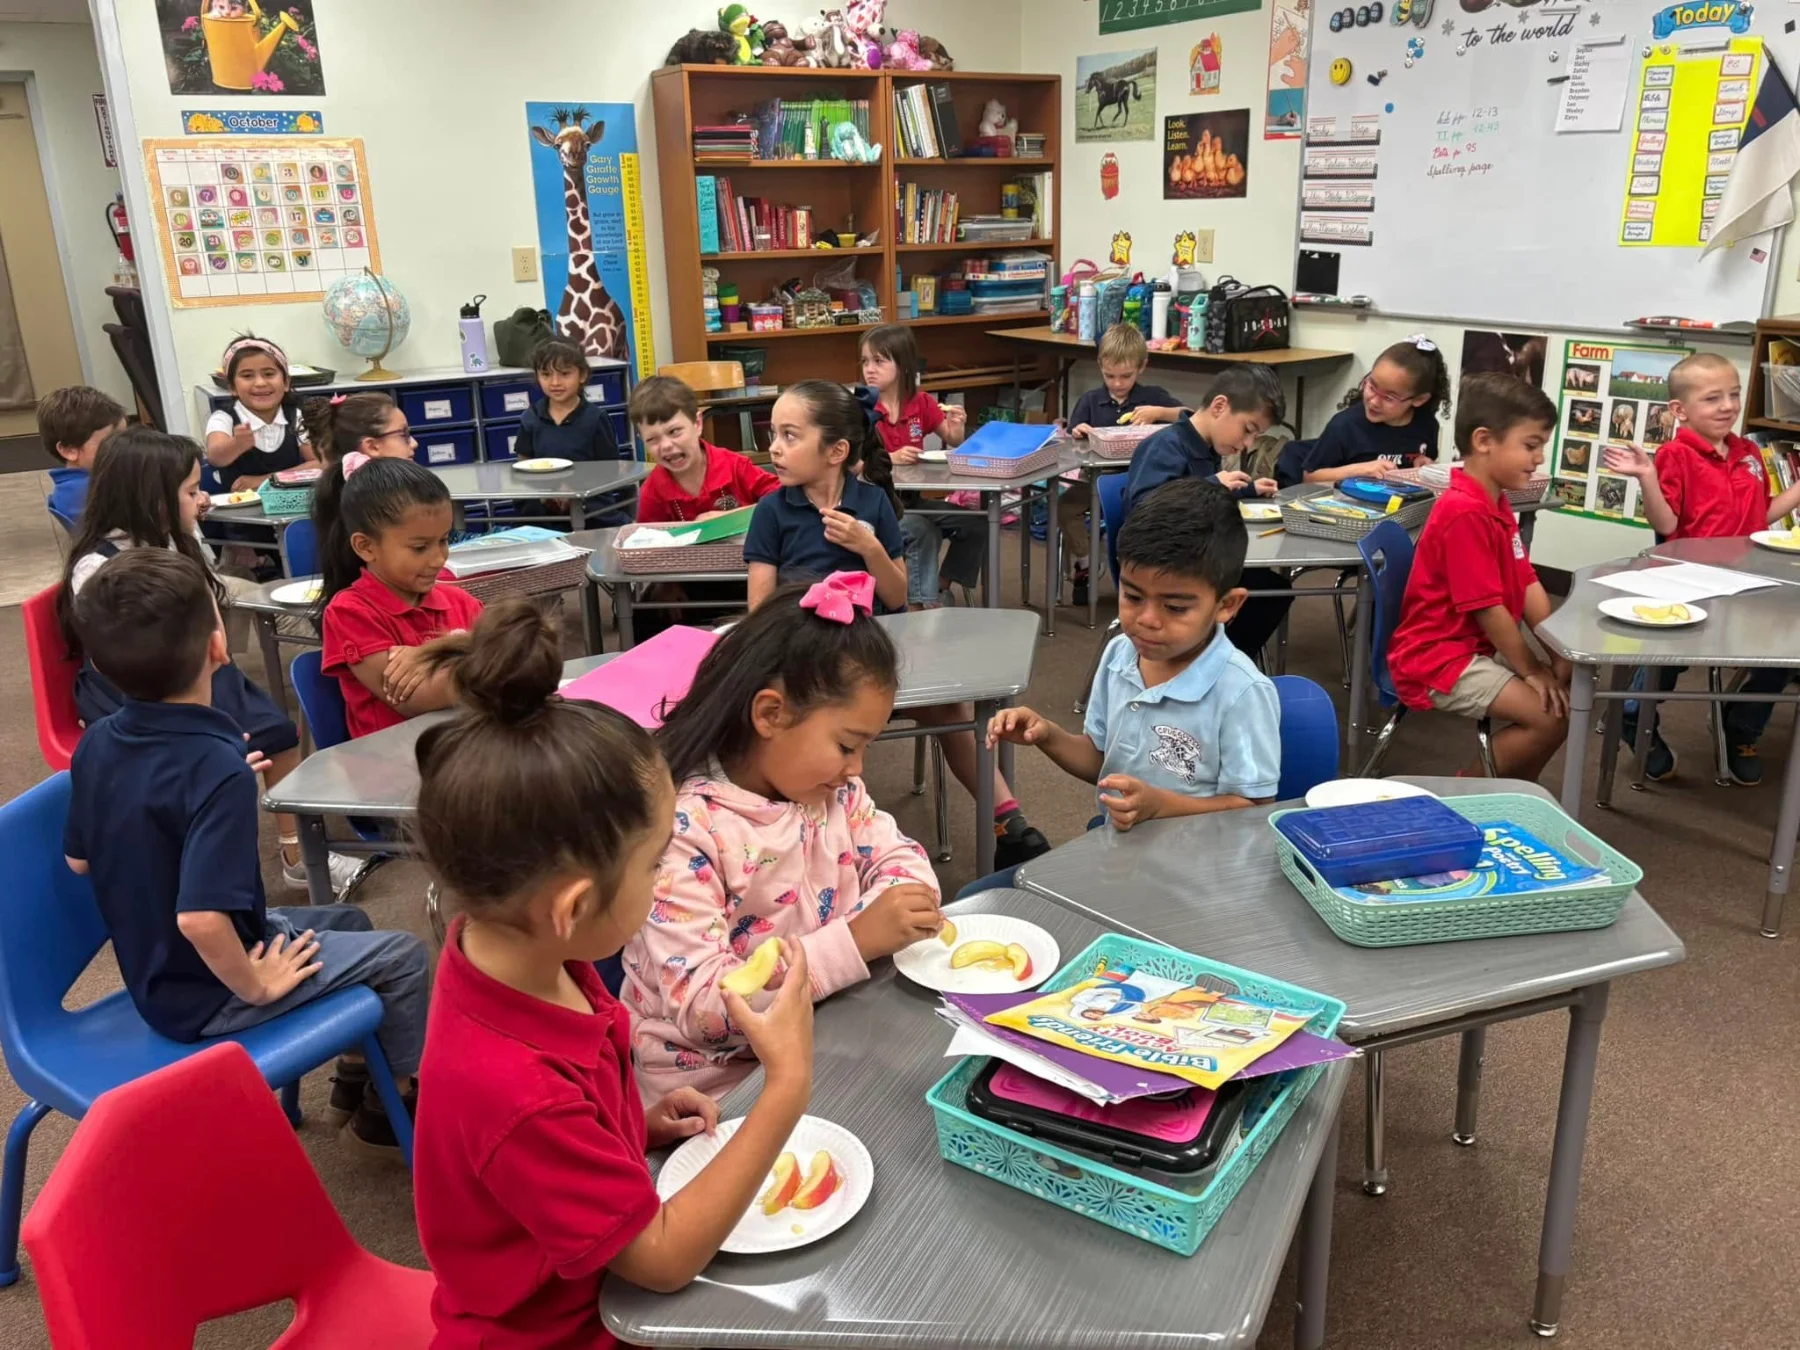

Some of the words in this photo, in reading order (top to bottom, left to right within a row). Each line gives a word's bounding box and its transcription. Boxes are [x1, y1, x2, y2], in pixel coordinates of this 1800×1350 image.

[1113, 1, 1123, 20] 2
[1674, 3, 1735, 25] Today
[1461, 27, 1483, 47] to
[1486, 22, 1516, 45] the
[1521, 13, 1575, 40] world
[230, 117, 278, 128] October
[1168, 120, 1186, 129] Look.
[1168, 130, 1190, 140] Listen.
[1167, 142, 1188, 151] Learn.
[590, 154, 612, 165] Gary
[586, 165, 617, 174] Giraffe
[1427, 163, 1466, 179] Spelling
[586, 176, 620, 184] Growth
[588, 186, 619, 196] Gauge
[180, 237, 192, 247] 20
[1572, 344, 1608, 359] Farm
[1484, 827, 1567, 880] Spelling
[1482, 847, 1532, 874] Poetry
[1028, 1015, 1128, 1054] Friends
[1132, 1047, 1216, 1072] Bible
